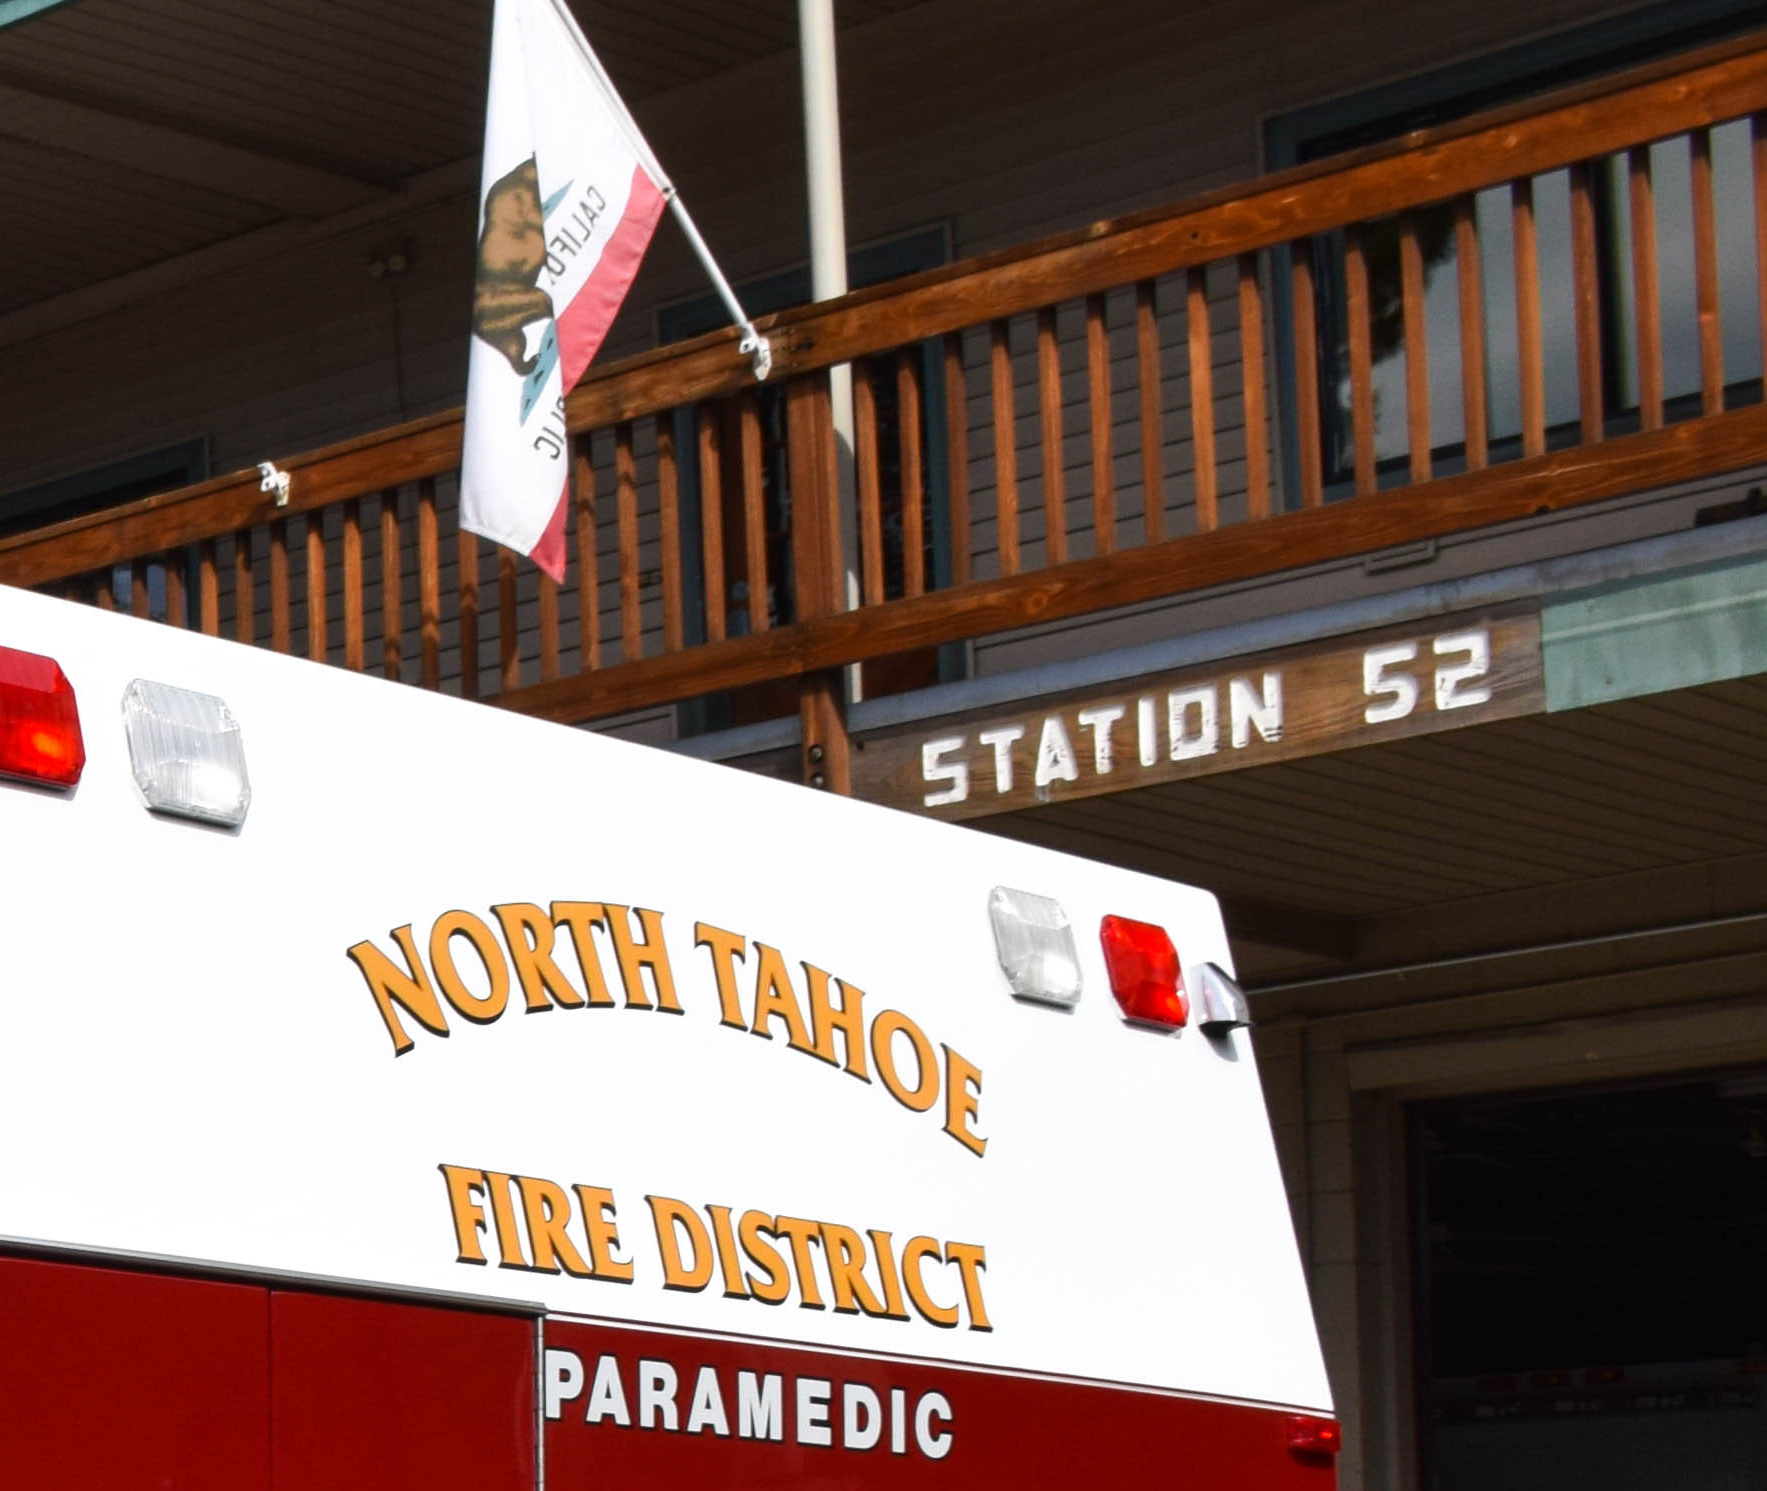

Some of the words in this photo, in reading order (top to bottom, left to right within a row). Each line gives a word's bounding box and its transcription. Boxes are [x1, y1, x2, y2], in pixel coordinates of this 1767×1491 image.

[922, 671, 1283, 806] STATION
[1363, 628, 1491, 724] 52
[346, 900, 685, 1058] NORTH
[694, 920, 989, 1158] TAHOE
[438, 1163, 634, 1284] FIRE
[643, 1194, 994, 1332] DISTRICT
[545, 1347, 954, 1460] PARAMEDIC
